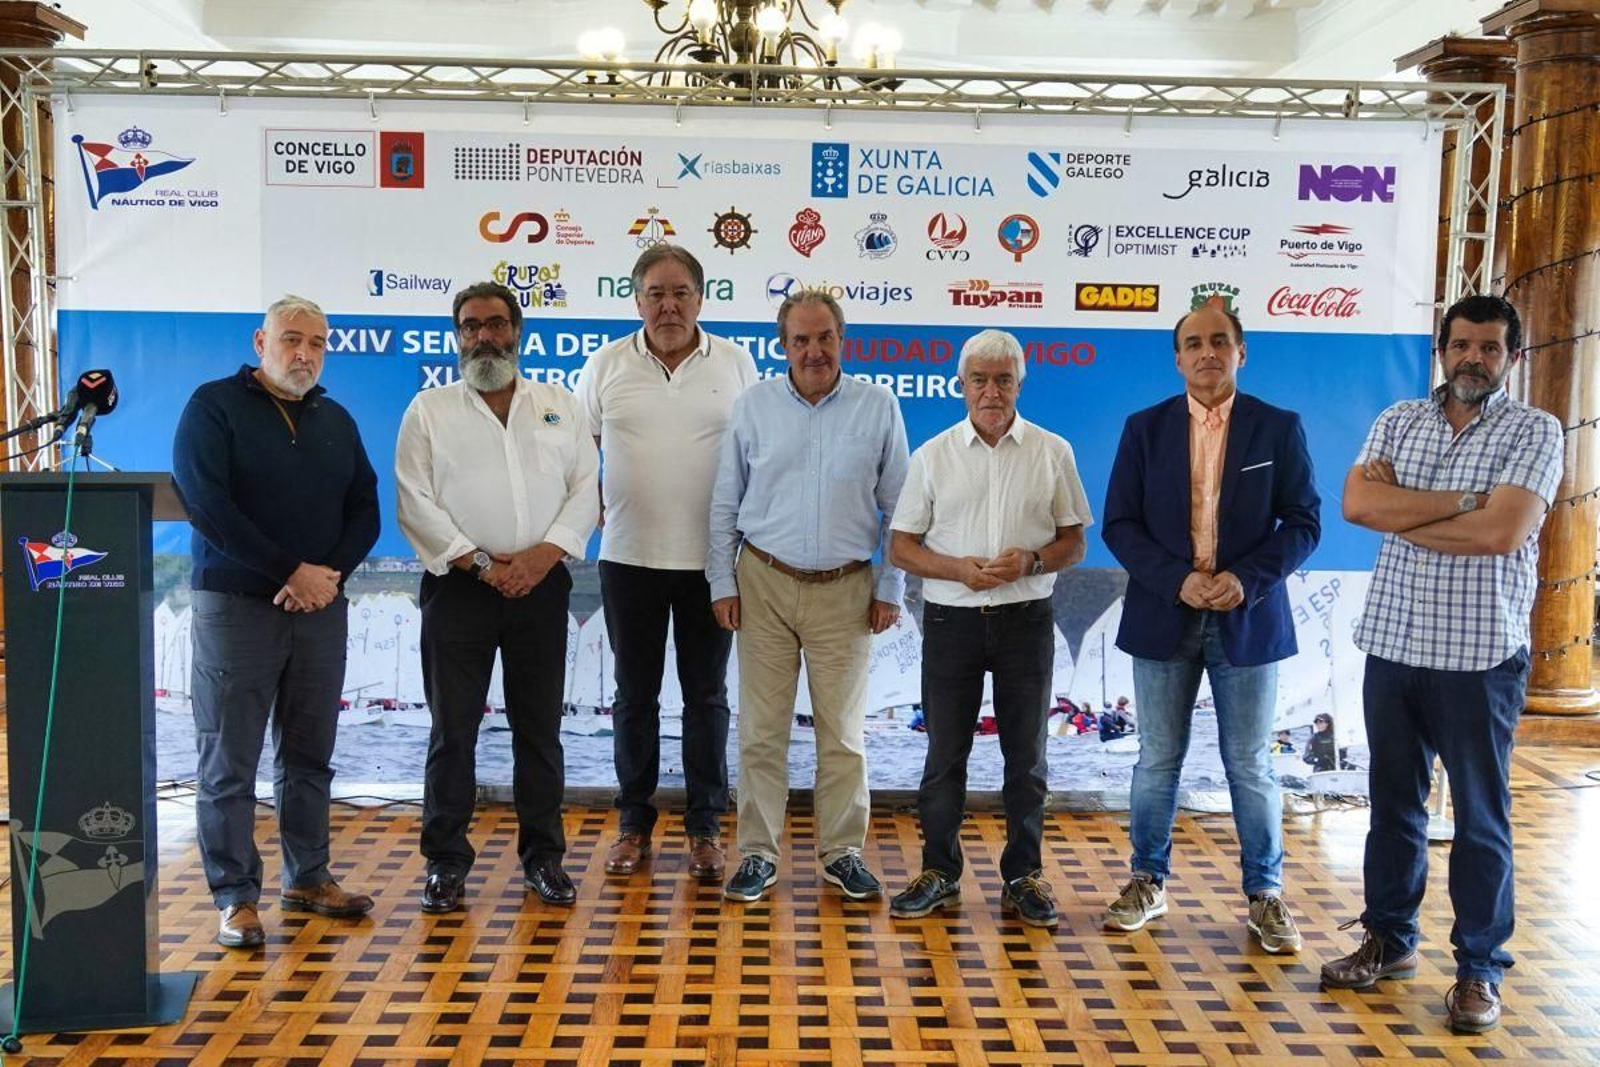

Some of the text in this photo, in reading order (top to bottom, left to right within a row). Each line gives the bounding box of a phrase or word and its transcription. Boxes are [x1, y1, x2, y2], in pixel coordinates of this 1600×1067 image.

[273, 141, 366, 157] CONCELLO
[526, 146, 643, 166] DEPUTACIÓN
[284, 160, 355, 175] DE VIGO
[703, 159, 781, 175] ríasbaixas
[858, 149, 943, 170] XUNTA
[1066, 153, 1131, 166] DEPORTE
[526, 166, 644, 184] PONTEVEDRA
[1065, 167, 1124, 180] GALEGO
[1163, 164, 1270, 200] galicia
[857, 175, 995, 197] DE GALICIA
[1115, 225, 1251, 241] EXCELLENCE CUP
[1114, 243, 1178, 256] OPTIMIST
[1280, 239, 1363, 253] Puerto de Vigo
[386, 274, 452, 294] Sailway
[1191, 282, 1240, 297] FRUTAS
[948, 288, 1043, 309] Tuypan
[1079, 285, 1158, 307] GADIS
[1267, 285, 1363, 318] Coca-Cola
[843, 338, 953, 363] IUDAD
